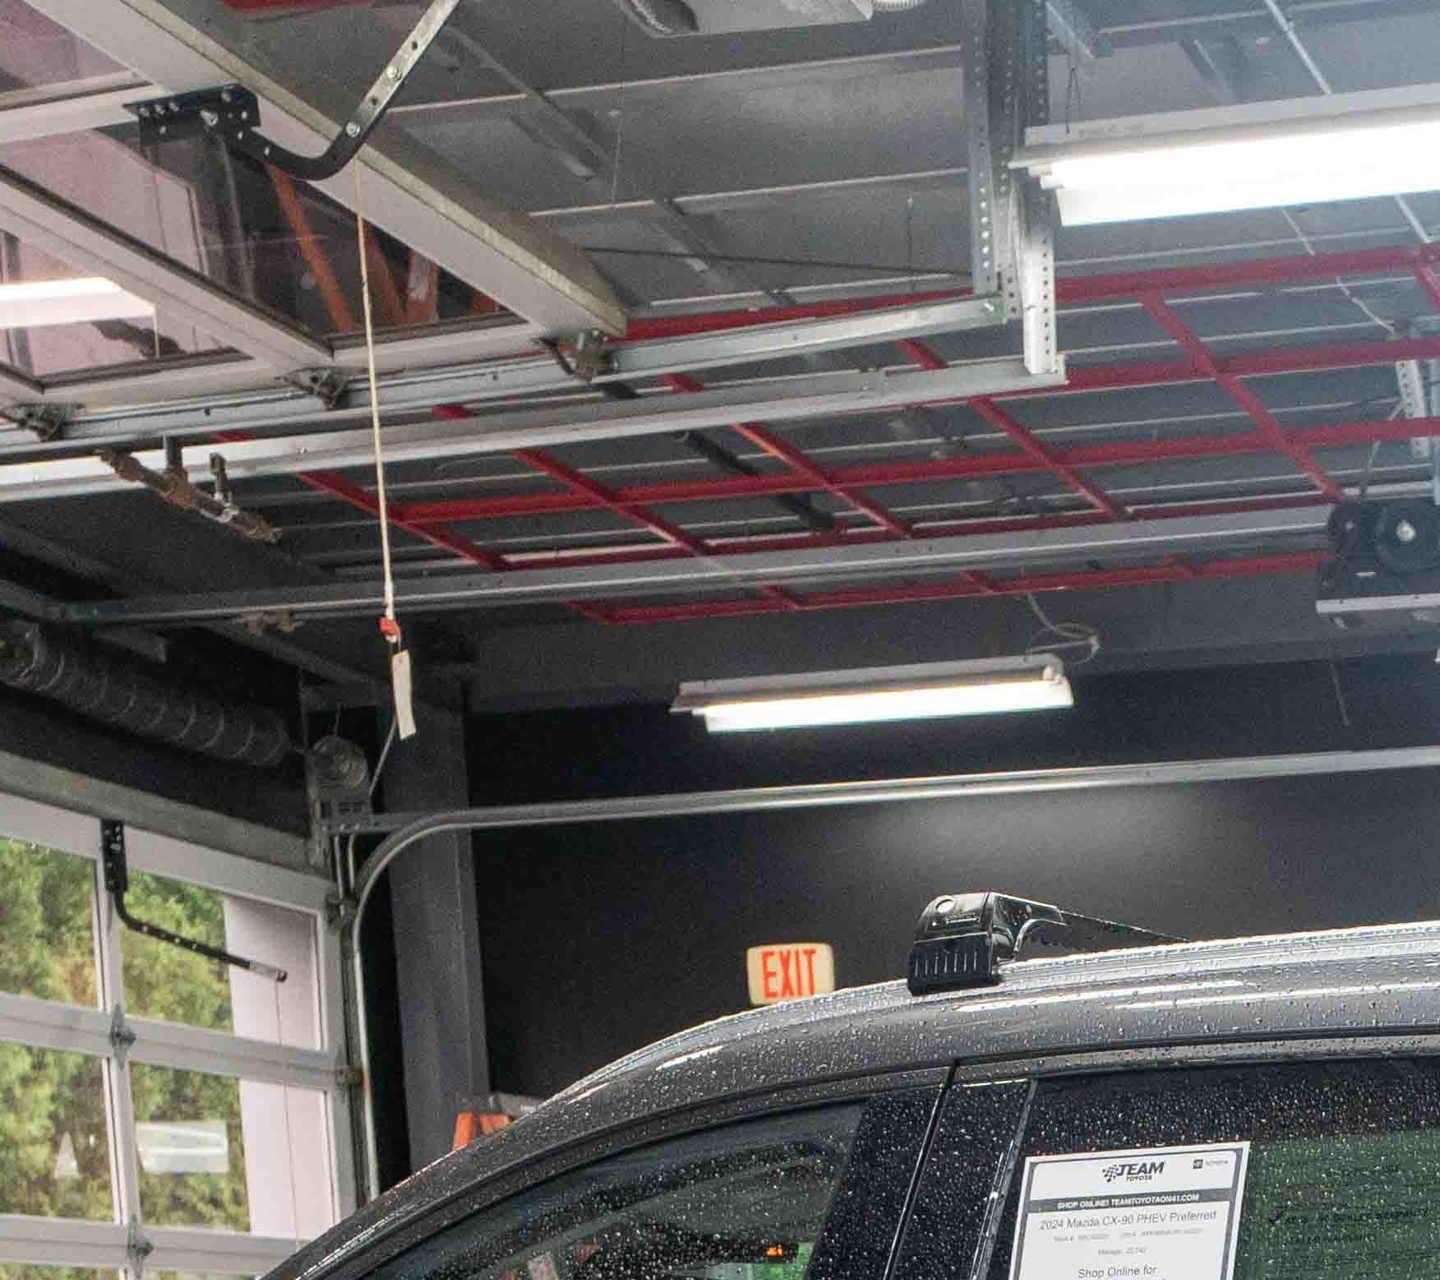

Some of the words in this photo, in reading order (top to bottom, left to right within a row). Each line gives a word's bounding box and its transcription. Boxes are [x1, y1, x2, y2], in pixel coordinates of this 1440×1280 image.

[761, 948, 817, 999] EXIT
[1116, 1161, 1165, 1176] TEAM
[1057, 1202, 1079, 1210] SHOP
[1040, 1219, 1064, 1230] 2024
[1067, 1217, 1100, 1228] Mazda
[1102, 1214, 1134, 1226] CX-90
[1137, 1212, 1167, 1224] PHEV
[1170, 1210, 1217, 1222] Preferred
[1078, 1268, 1105, 1279] Shop
[1107, 1266, 1140, 1277] Online
[1143, 1265, 1157, 1275] for
